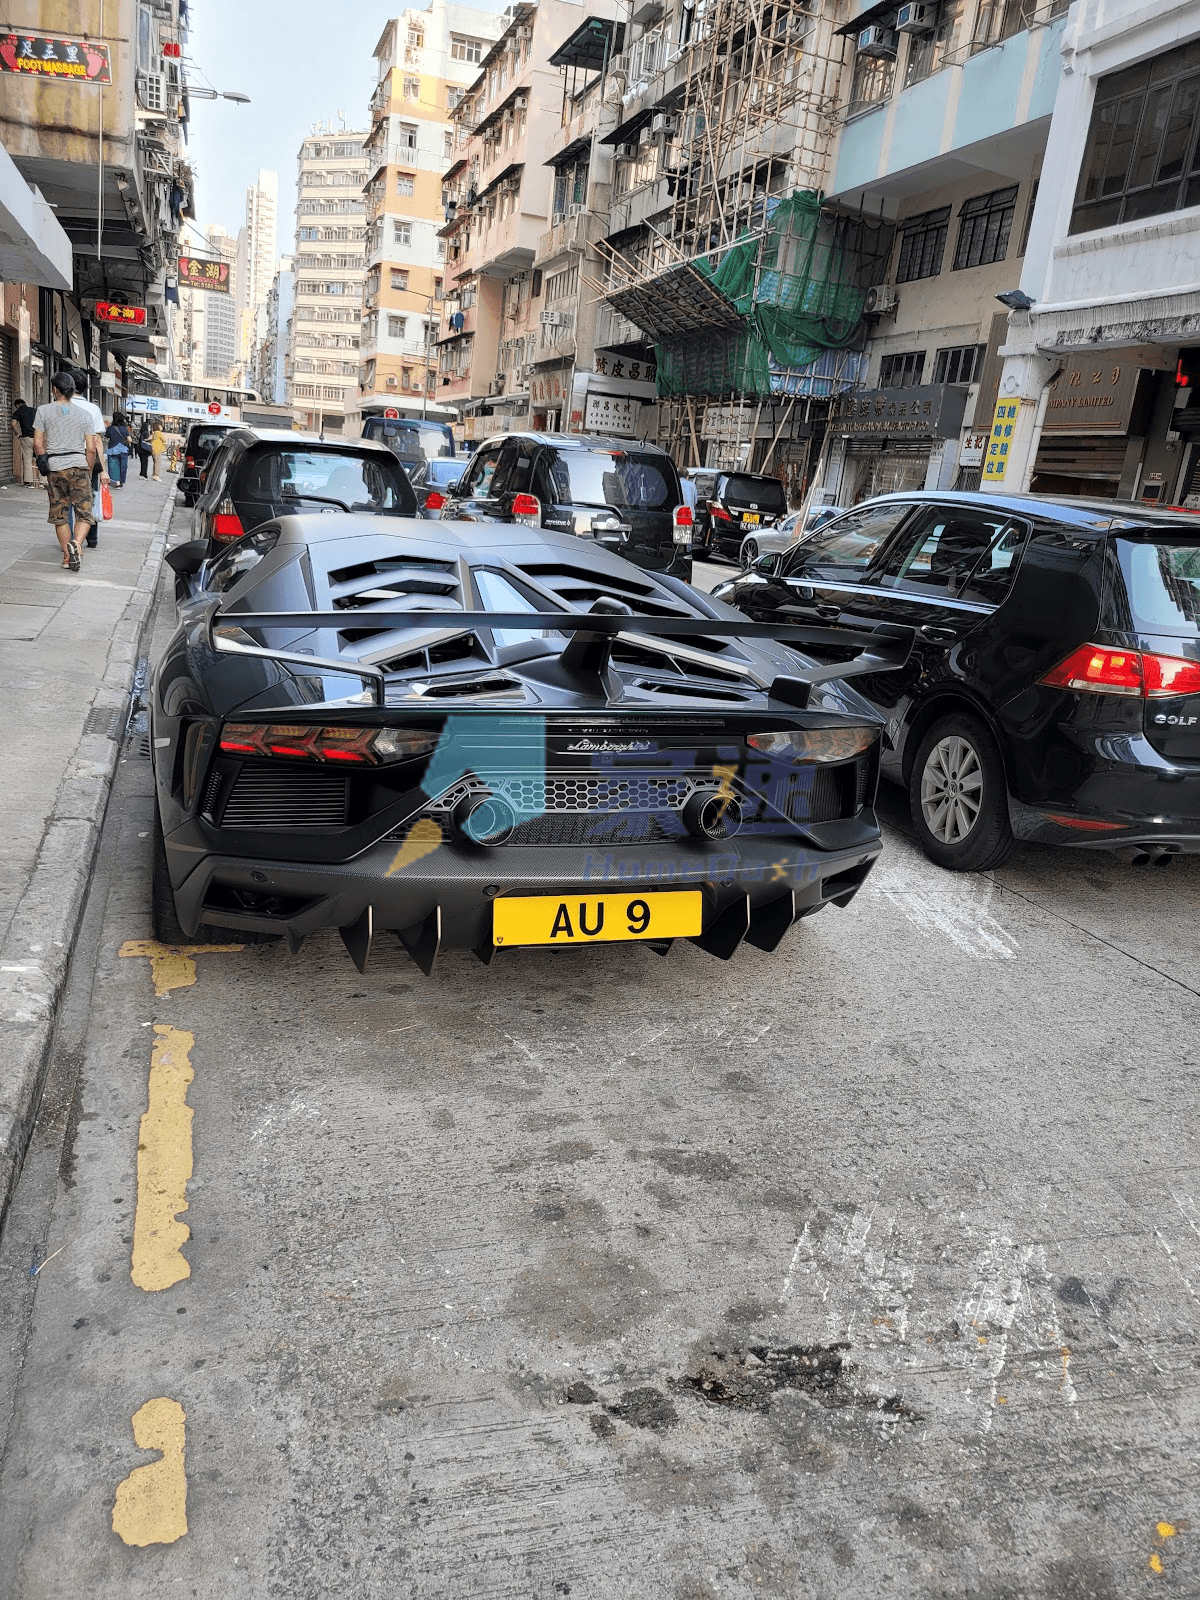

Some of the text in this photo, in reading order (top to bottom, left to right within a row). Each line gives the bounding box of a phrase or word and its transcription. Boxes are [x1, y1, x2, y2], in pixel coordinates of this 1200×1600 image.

[17, 58, 87, 76] FOOT MASSAGE
[188, 260, 220, 280] 金湖
[109, 306, 135, 318] 金湖
[1048, 396, 1115, 409] MPANY LIMITED
[1154, 714, 1198, 726] GOLF
[567, 739, 651, 753] Lamborghini
[549, 899, 651, 938] AU 9
